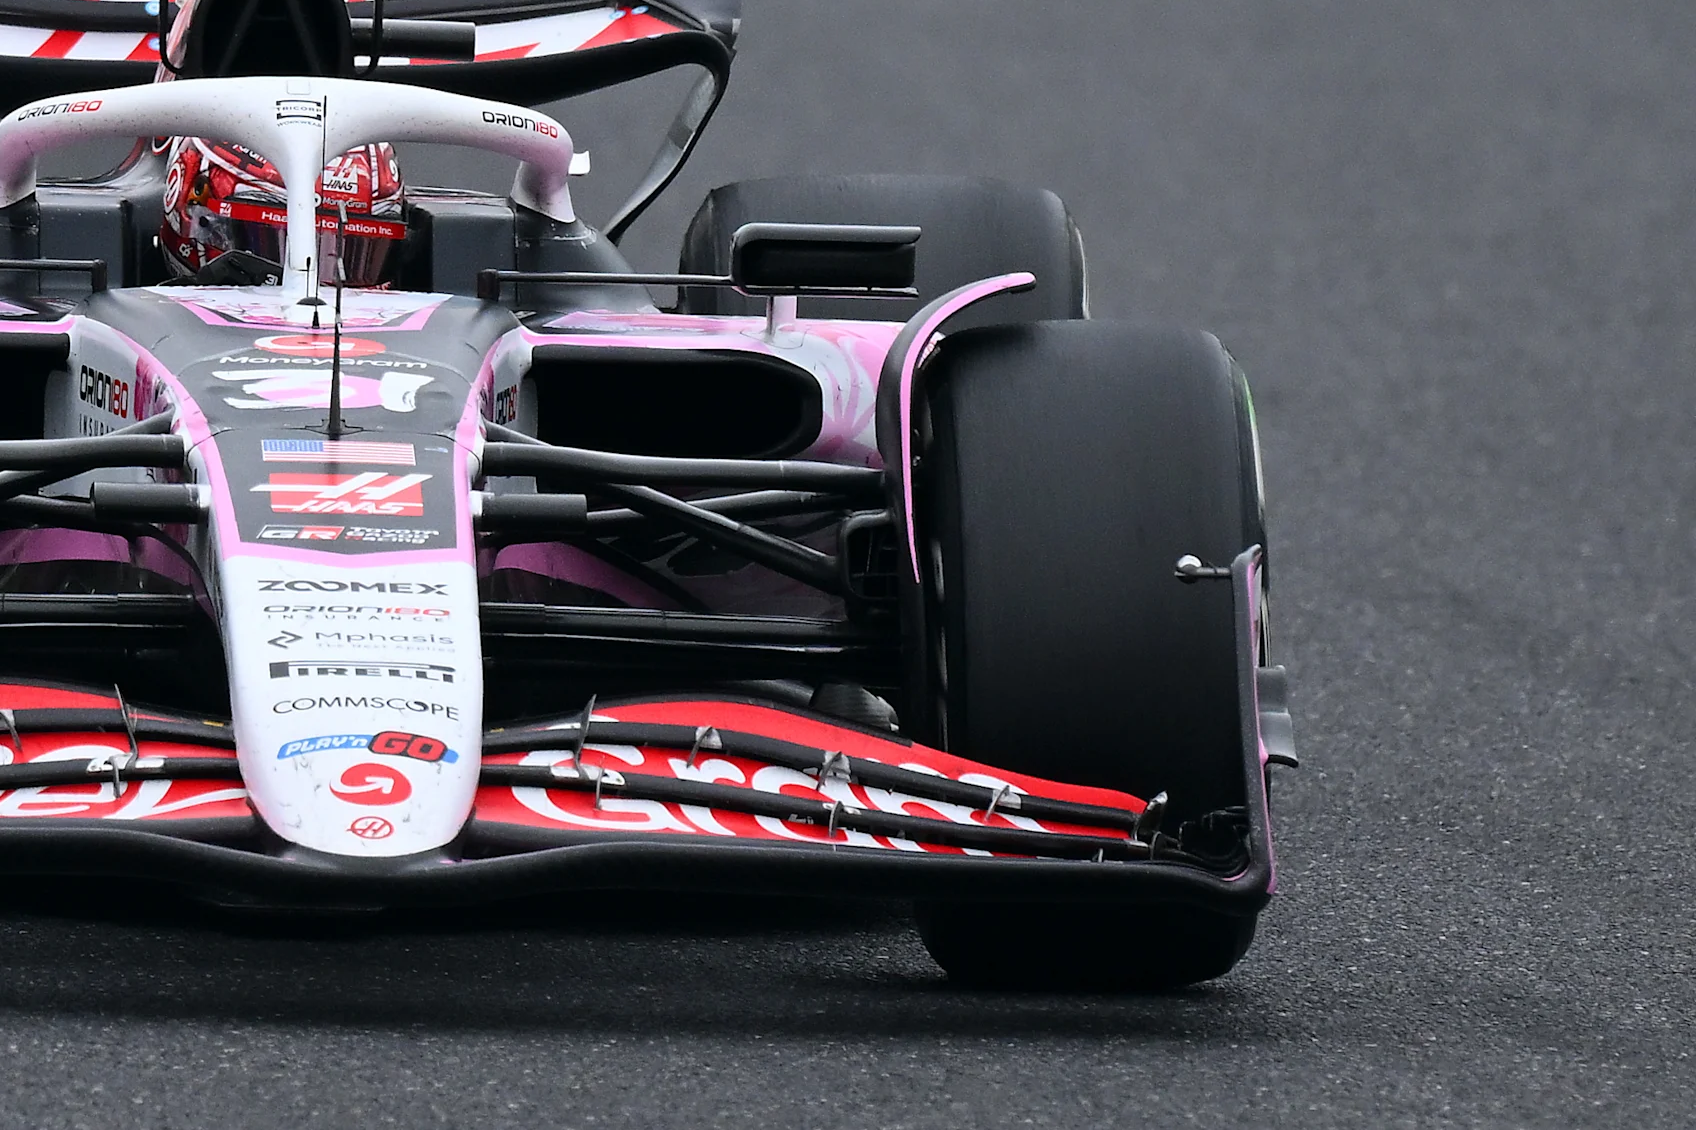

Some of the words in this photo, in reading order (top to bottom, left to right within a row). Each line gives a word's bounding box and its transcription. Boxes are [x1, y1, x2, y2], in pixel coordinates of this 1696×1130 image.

[17, 100, 103, 122] ORION180
[482, 111, 558, 139] ORION180
[261, 211, 287, 223] Haa
[378, 225, 394, 236] Inc.
[292, 500, 406, 515] HAAS
[261, 528, 337, 540] GR
[258, 580, 449, 595] ZOOMEX
[263, 605, 450, 617] ORION180
[315, 632, 454, 645] Mphasis
[269, 660, 456, 684] PIRELLI
[273, 696, 460, 721] COMMSCOPE
[285, 735, 368, 756] PLAY'n
[371, 732, 446, 762] GO
